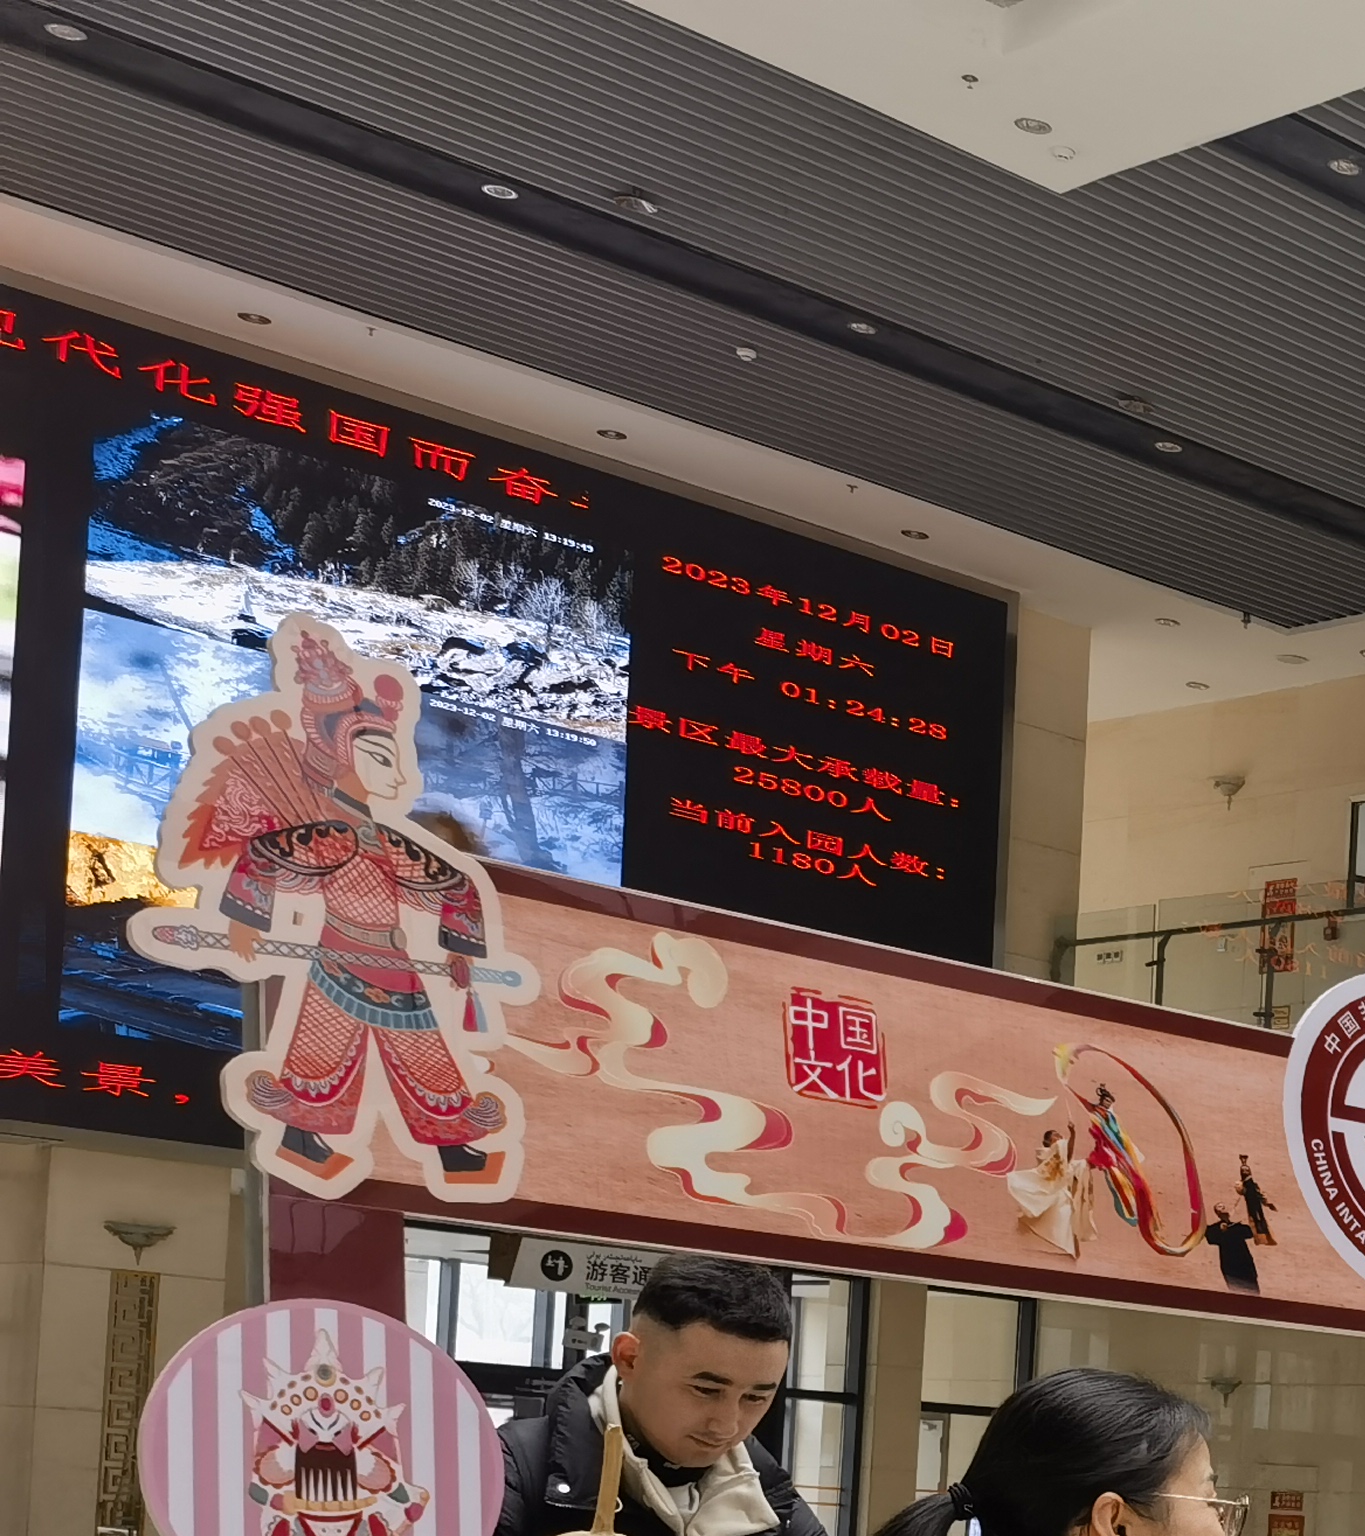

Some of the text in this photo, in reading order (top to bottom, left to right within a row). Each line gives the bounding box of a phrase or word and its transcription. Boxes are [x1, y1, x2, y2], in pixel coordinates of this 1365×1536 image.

[428, 497, 495, 524] 2023-12-02
[661, 556, 955, 659] 2023年12月02日
[753, 627, 877, 678] 星期六
[671, 648, 949, 741] 下午 01:24:28
[429, 698, 497, 723] 2023-12-02
[545, 728, 598, 748] 13:19:50
[732, 765, 893, 823] 25800人
[748, 841, 878, 887] 1180人
[787, 994, 879, 1056] 中国
[792, 1055, 886, 1103] 文化
[1310, 1137, 1338, 1201] CHINA
[585, 1281, 612, 1293] Tourist
